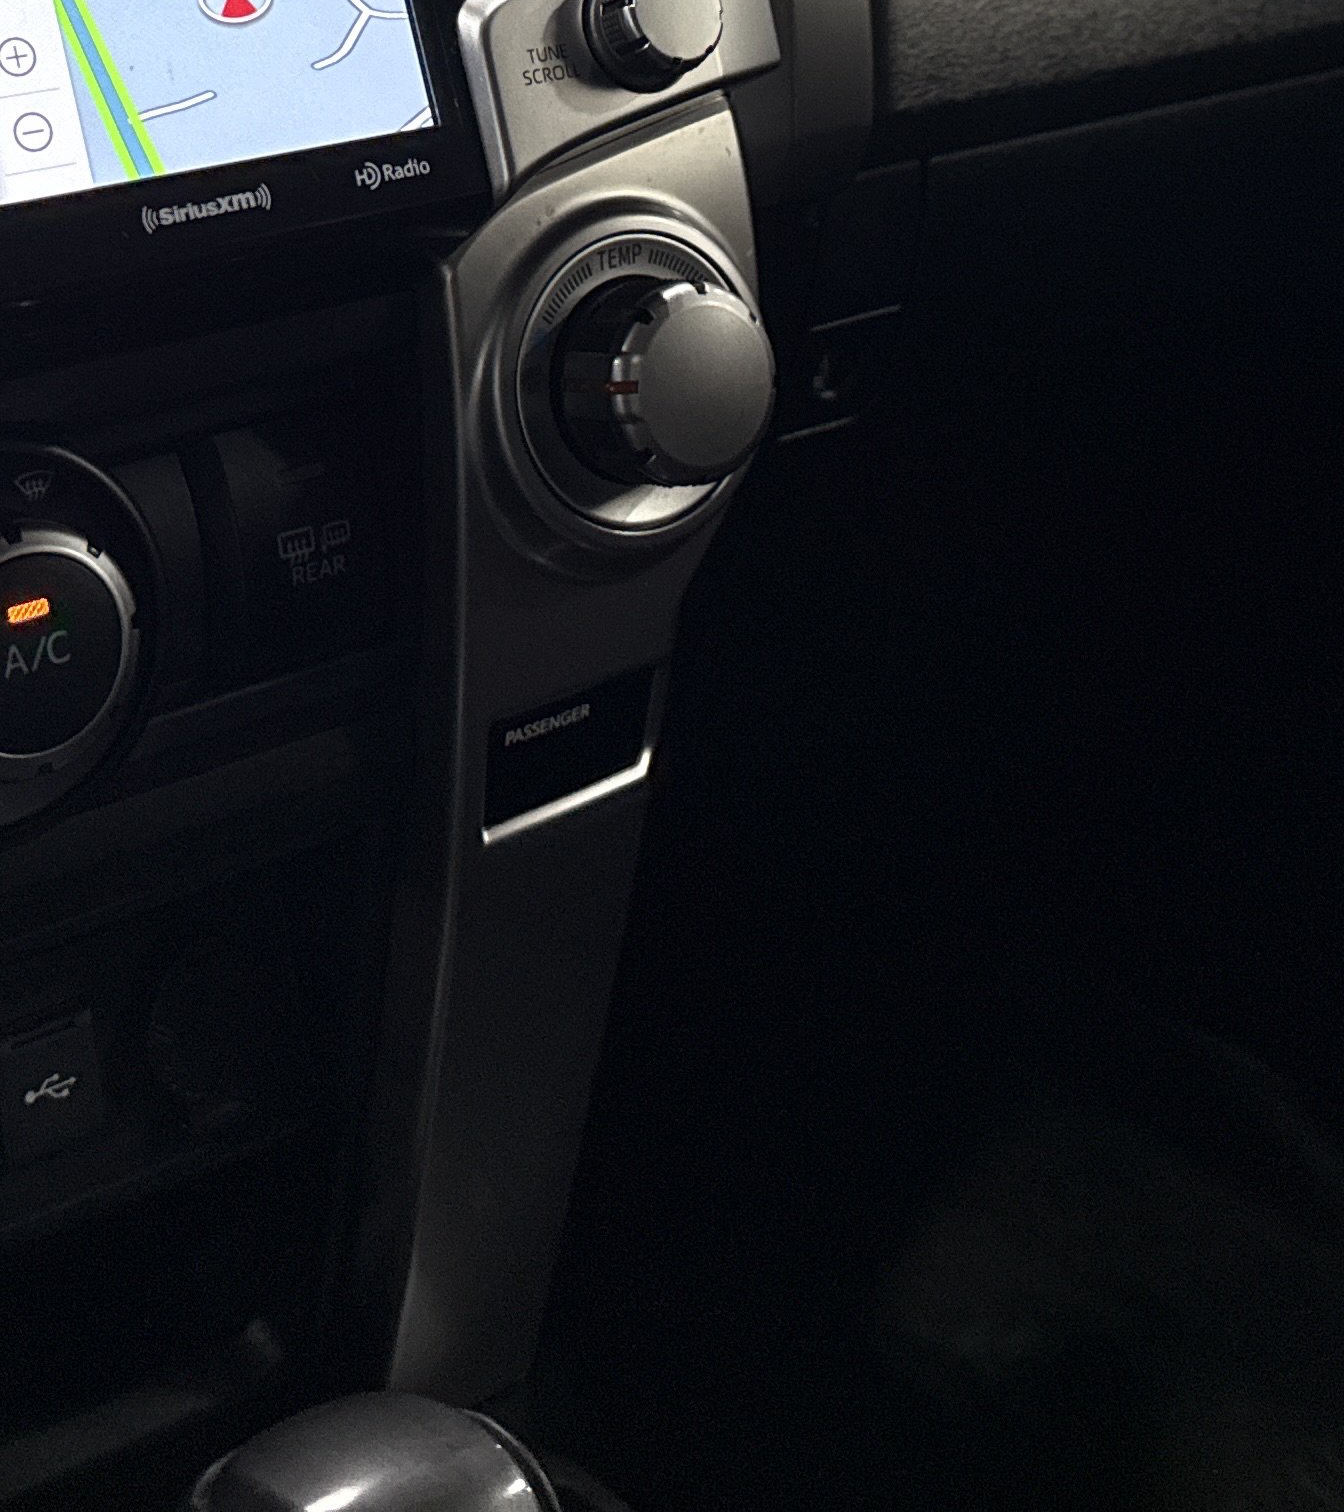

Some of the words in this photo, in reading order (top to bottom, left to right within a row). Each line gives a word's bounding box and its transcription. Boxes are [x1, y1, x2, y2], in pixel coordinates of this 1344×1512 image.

[527, 43, 569, 64] TUNE
[523, 64, 579, 86] SCROLL
[383, 159, 431, 183] Radio
[597, 244, 642, 271] TEMP
[292, 555, 346, 587] REAR
[4, 629, 72, 680] A/C
[505, 704, 590, 747] PASSENGER
